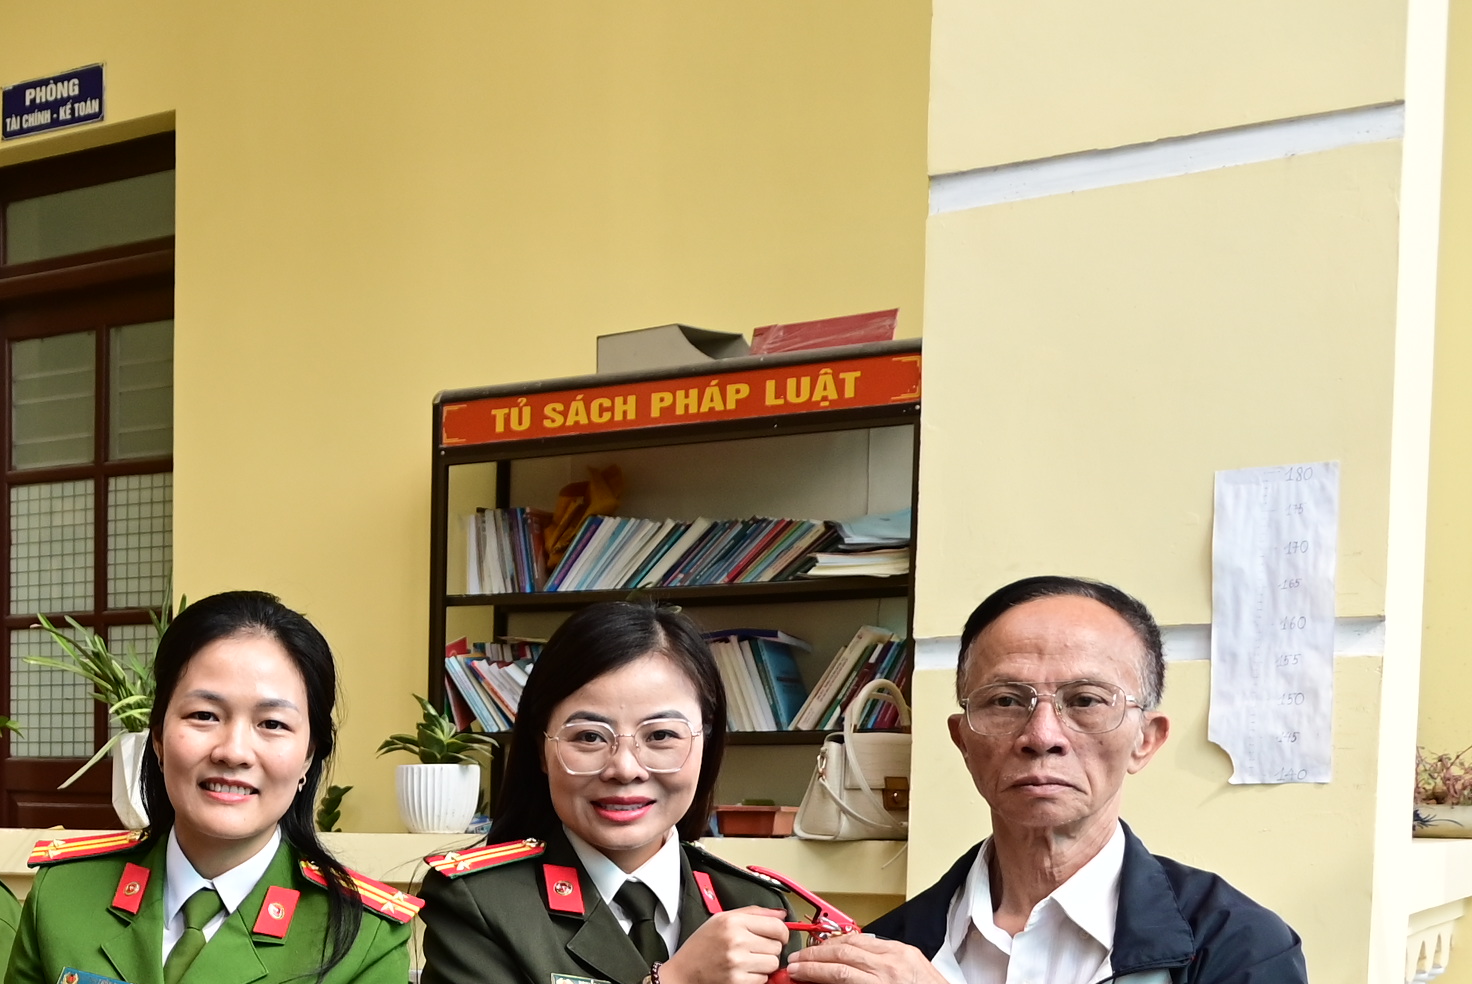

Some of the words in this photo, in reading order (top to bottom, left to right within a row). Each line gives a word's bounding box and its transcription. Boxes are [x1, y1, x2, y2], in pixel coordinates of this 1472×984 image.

[25, 78, 79, 106] PHÒNG
[6, 114, 20, 132] TÀI
[22, 108, 51, 129] CHÍNH
[59, 101, 72, 121] KẾ
[74, 98, 99, 117] TOÁN
[491, 396, 530, 433] TỦ
[542, 394, 636, 429] SÁCH
[650, 379, 750, 418] PHÁP
[764, 367, 861, 407] LUẬT
[1285, 466, 1313, 482] 180
[1280, 616, 1307, 630] 160
